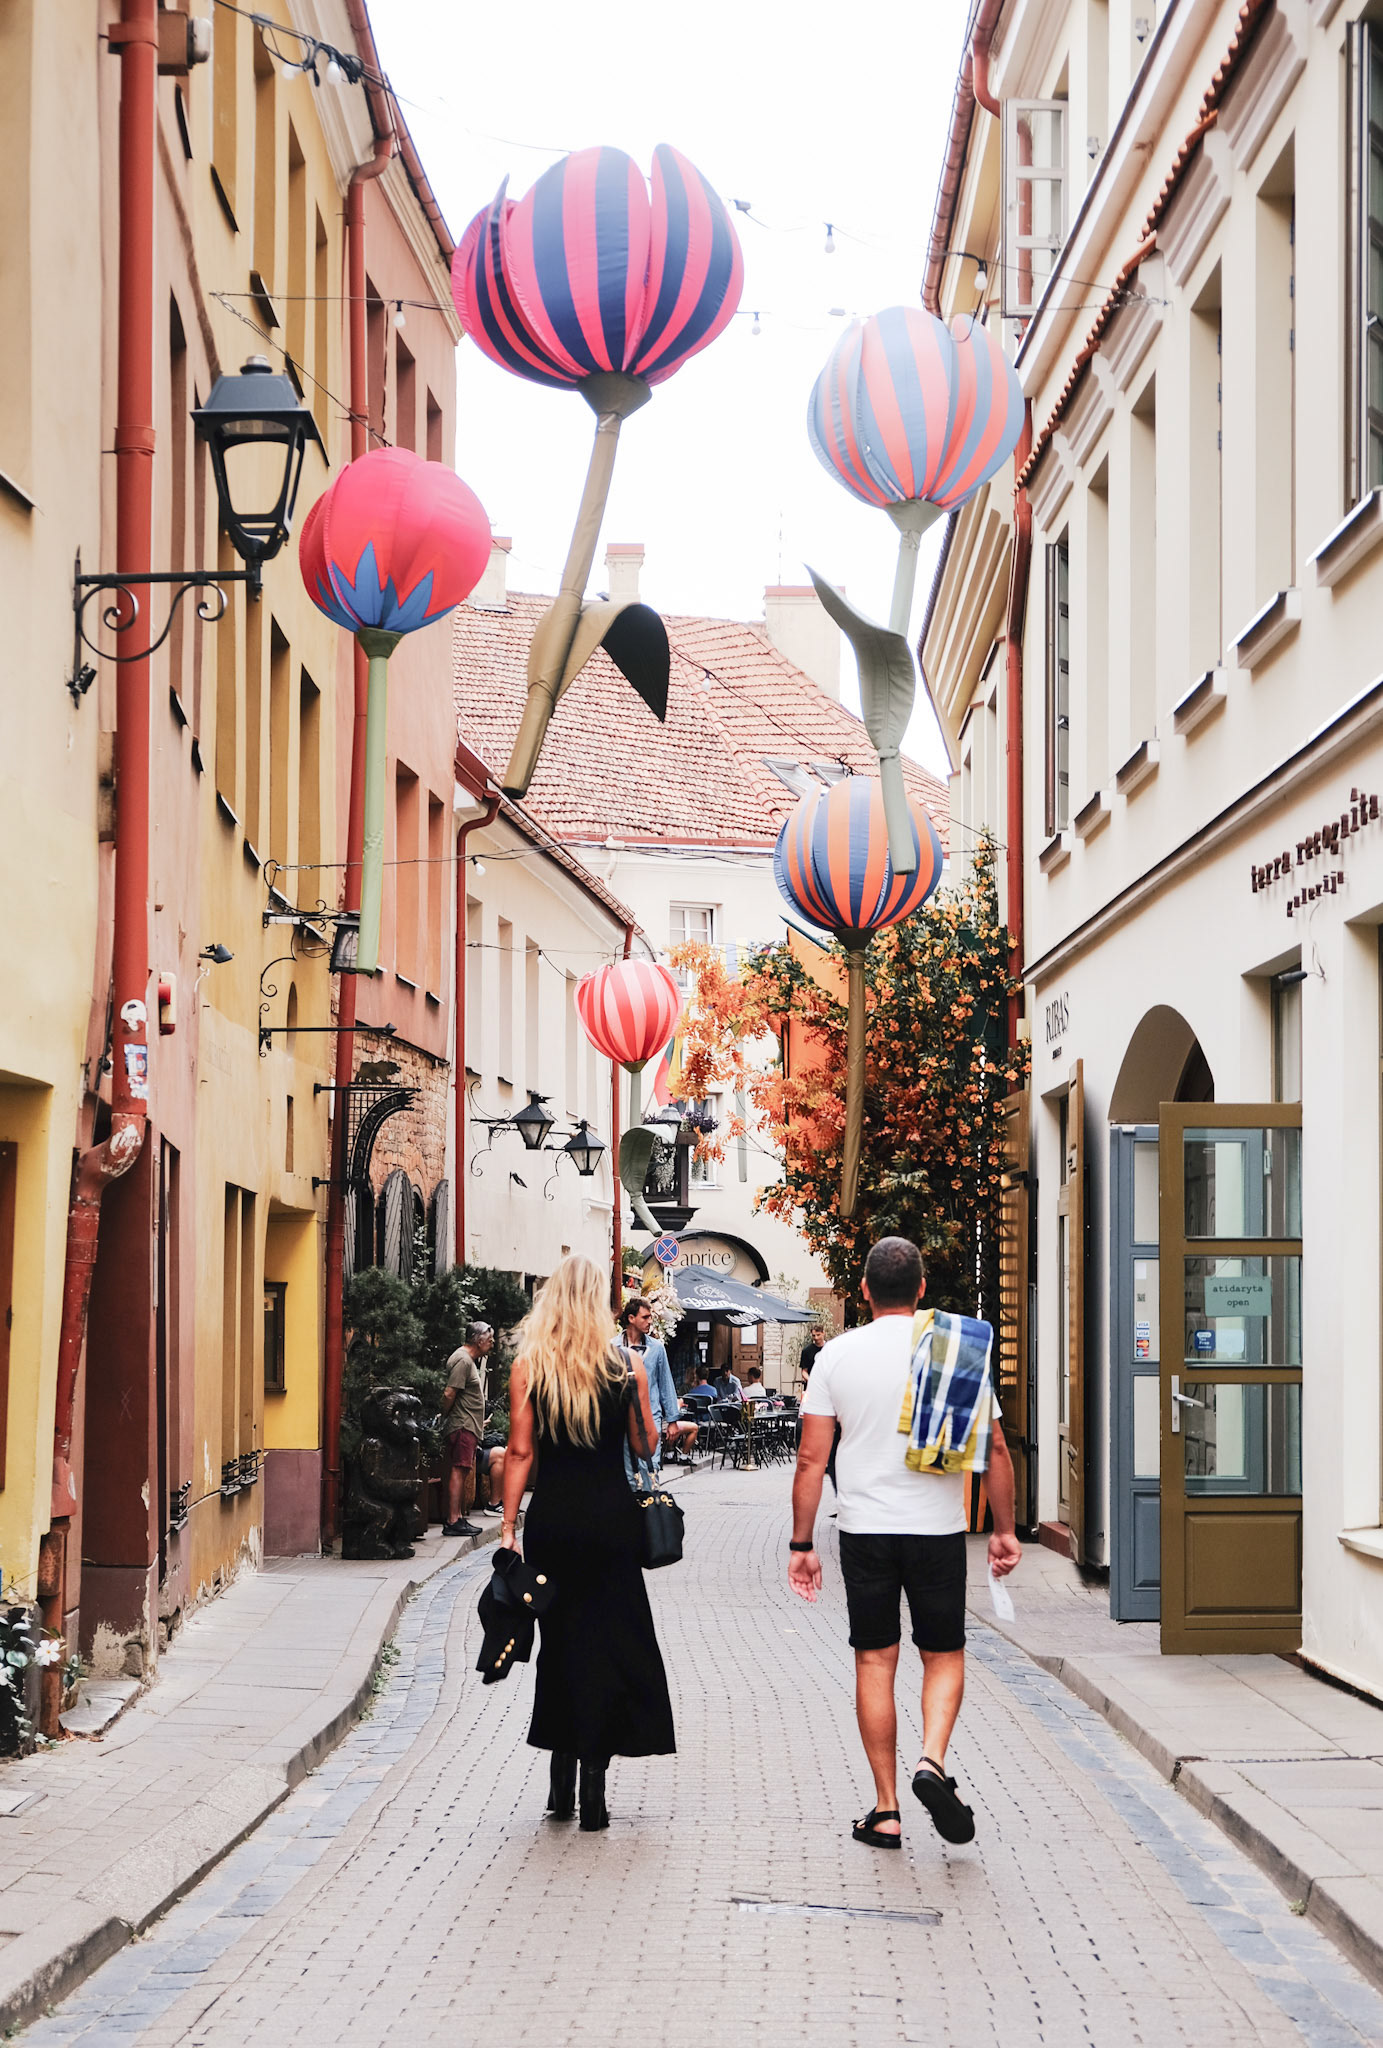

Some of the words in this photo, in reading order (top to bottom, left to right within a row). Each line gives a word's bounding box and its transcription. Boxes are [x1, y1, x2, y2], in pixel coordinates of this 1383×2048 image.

[1251, 851, 1290, 893] terra
[1296, 787, 1379, 865] recognita
[1287, 871, 1344, 917] galerija
[669, 1248, 731, 1266] aprice
[1212, 1284, 1263, 1294] atidaryta
[1226, 1299, 1249, 1308] open
